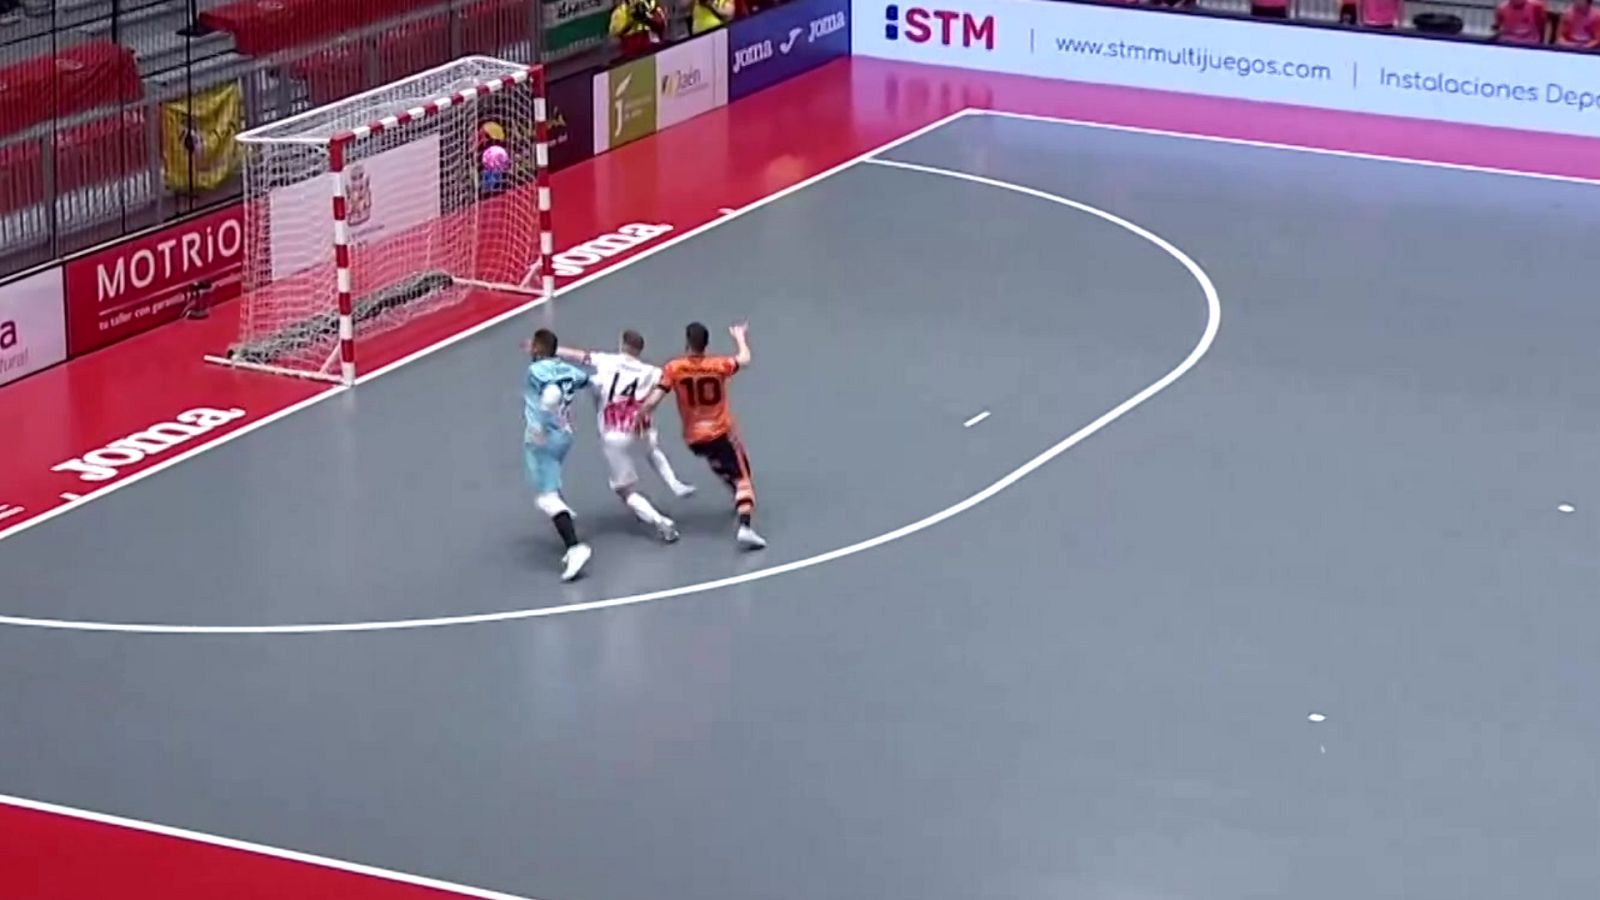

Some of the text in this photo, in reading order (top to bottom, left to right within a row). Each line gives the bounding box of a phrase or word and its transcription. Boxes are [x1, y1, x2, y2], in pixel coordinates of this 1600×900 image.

[904, 7, 995, 51] STM
[1056, 37, 1332, 80] www.stmmultijuegos.com
[1379, 67, 1540, 102] Instalaciones
[608, 371, 640, 405] 14
[680, 375, 722, 408] 10
